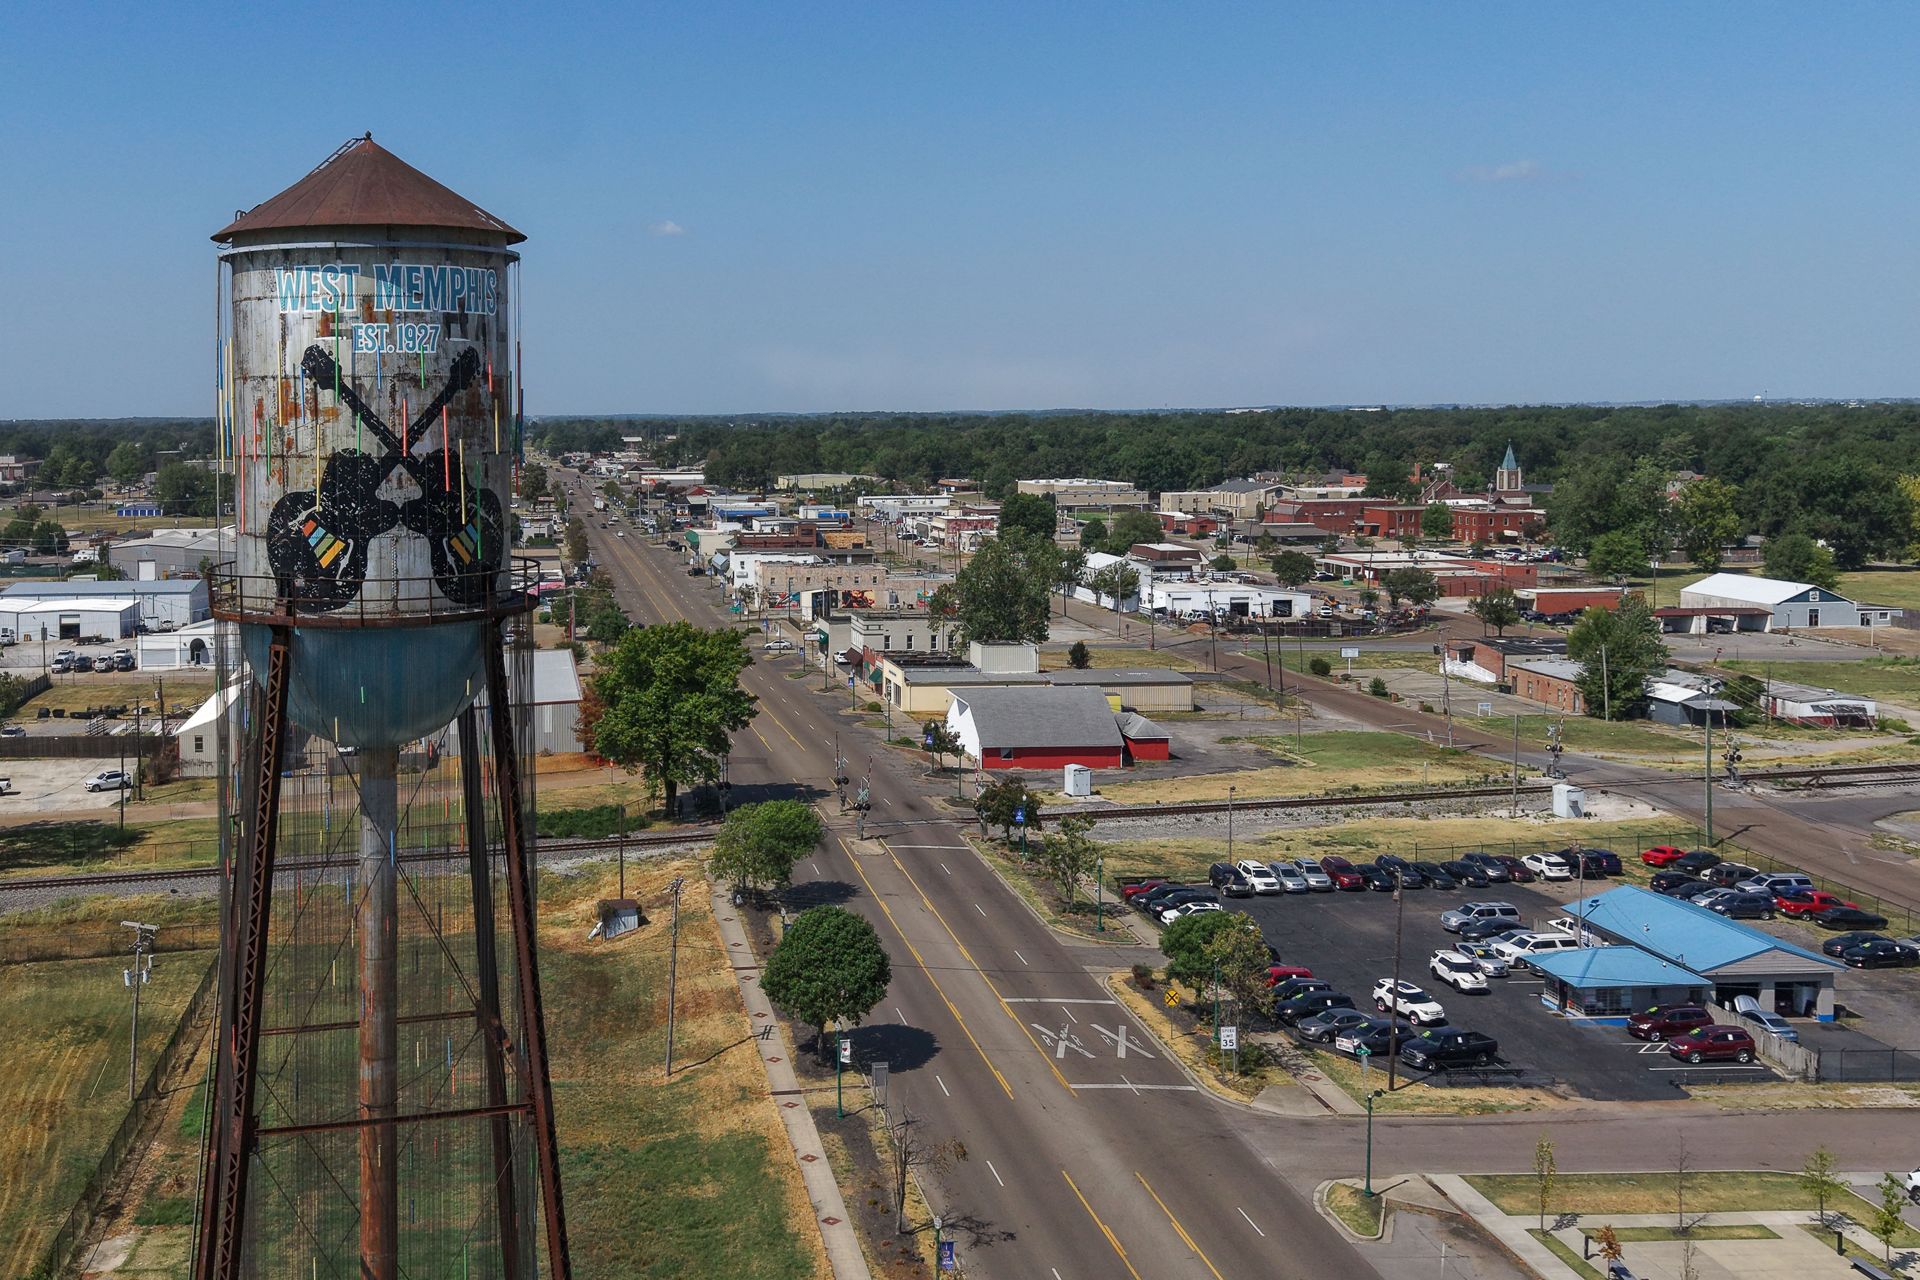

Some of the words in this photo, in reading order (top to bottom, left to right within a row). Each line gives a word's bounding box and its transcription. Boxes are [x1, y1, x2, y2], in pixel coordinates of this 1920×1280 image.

[274, 264, 361, 314] WEST
[373, 264, 497, 315] MEMPHIS
[1222, 1039, 1235, 1047] 35
